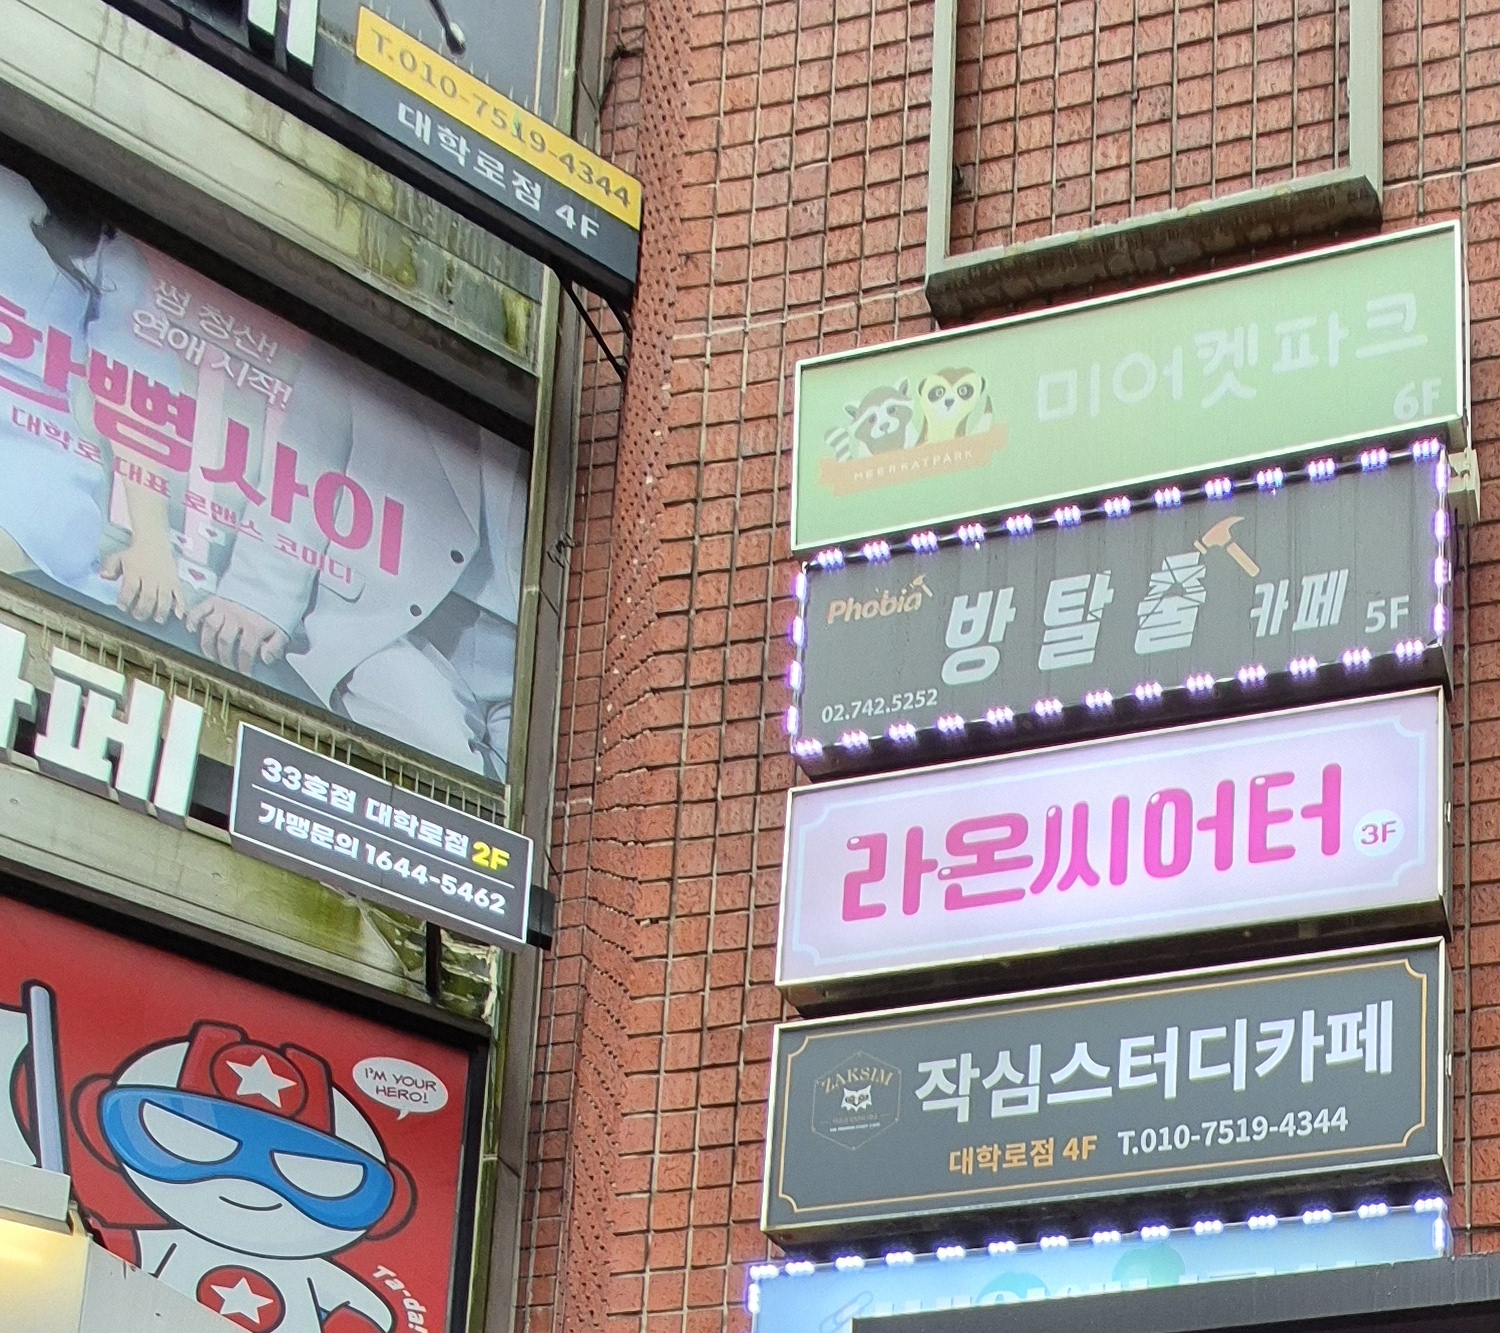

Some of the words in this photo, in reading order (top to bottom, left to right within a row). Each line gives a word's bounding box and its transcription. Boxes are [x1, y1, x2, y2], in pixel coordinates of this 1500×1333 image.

[370, 28, 631, 209] T.010-7519-4344
[397, 101, 542, 212] 대학로점
[555, 203, 600, 239] 4F
[156, 278, 192, 318] 썸
[132, 308, 205, 367] 연애
[211, 352, 294, 410] 시작!
[1036, 292, 1430, 423] 미어켓파크
[1391, 377, 1441, 418] 6F
[12, 405, 103, 465] 대학로
[115, 456, 171, 499] 대표
[185, 493, 264, 542] 로맨스
[275, 534, 352, 584] 코미디
[826, 583, 922, 625] Phobia
[1249, 569, 1350, 638] 카페
[1364, 594, 1410, 635] 5F
[820, 688, 938, 724] 02.742.5252
[260, 757, 358, 814] 33호점
[364, 797, 471, 859] 대학로점
[472, 841, 511, 871] 2F
[841, 763, 1342, 922] 라온씨어터
[1359, 820, 1398, 846] 3F
[258, 801, 359, 860] 가맹문의
[365, 843, 506, 915] 1644-5462
[364, 1067, 387, 1081] I'M
[392, 1073, 437, 1092] YOUR
[375, 1085, 428, 1103] HERO!
[820, 1066, 894, 1095] ZAKSIM
[913, 1000, 1396, 1124] 작심스터디카페
[948, 1136, 1056, 1176] 대학로점
[1063, 1135, 1098, 1163] 4F
[1117, 1107, 1349, 1157] T.010-7519-4344
